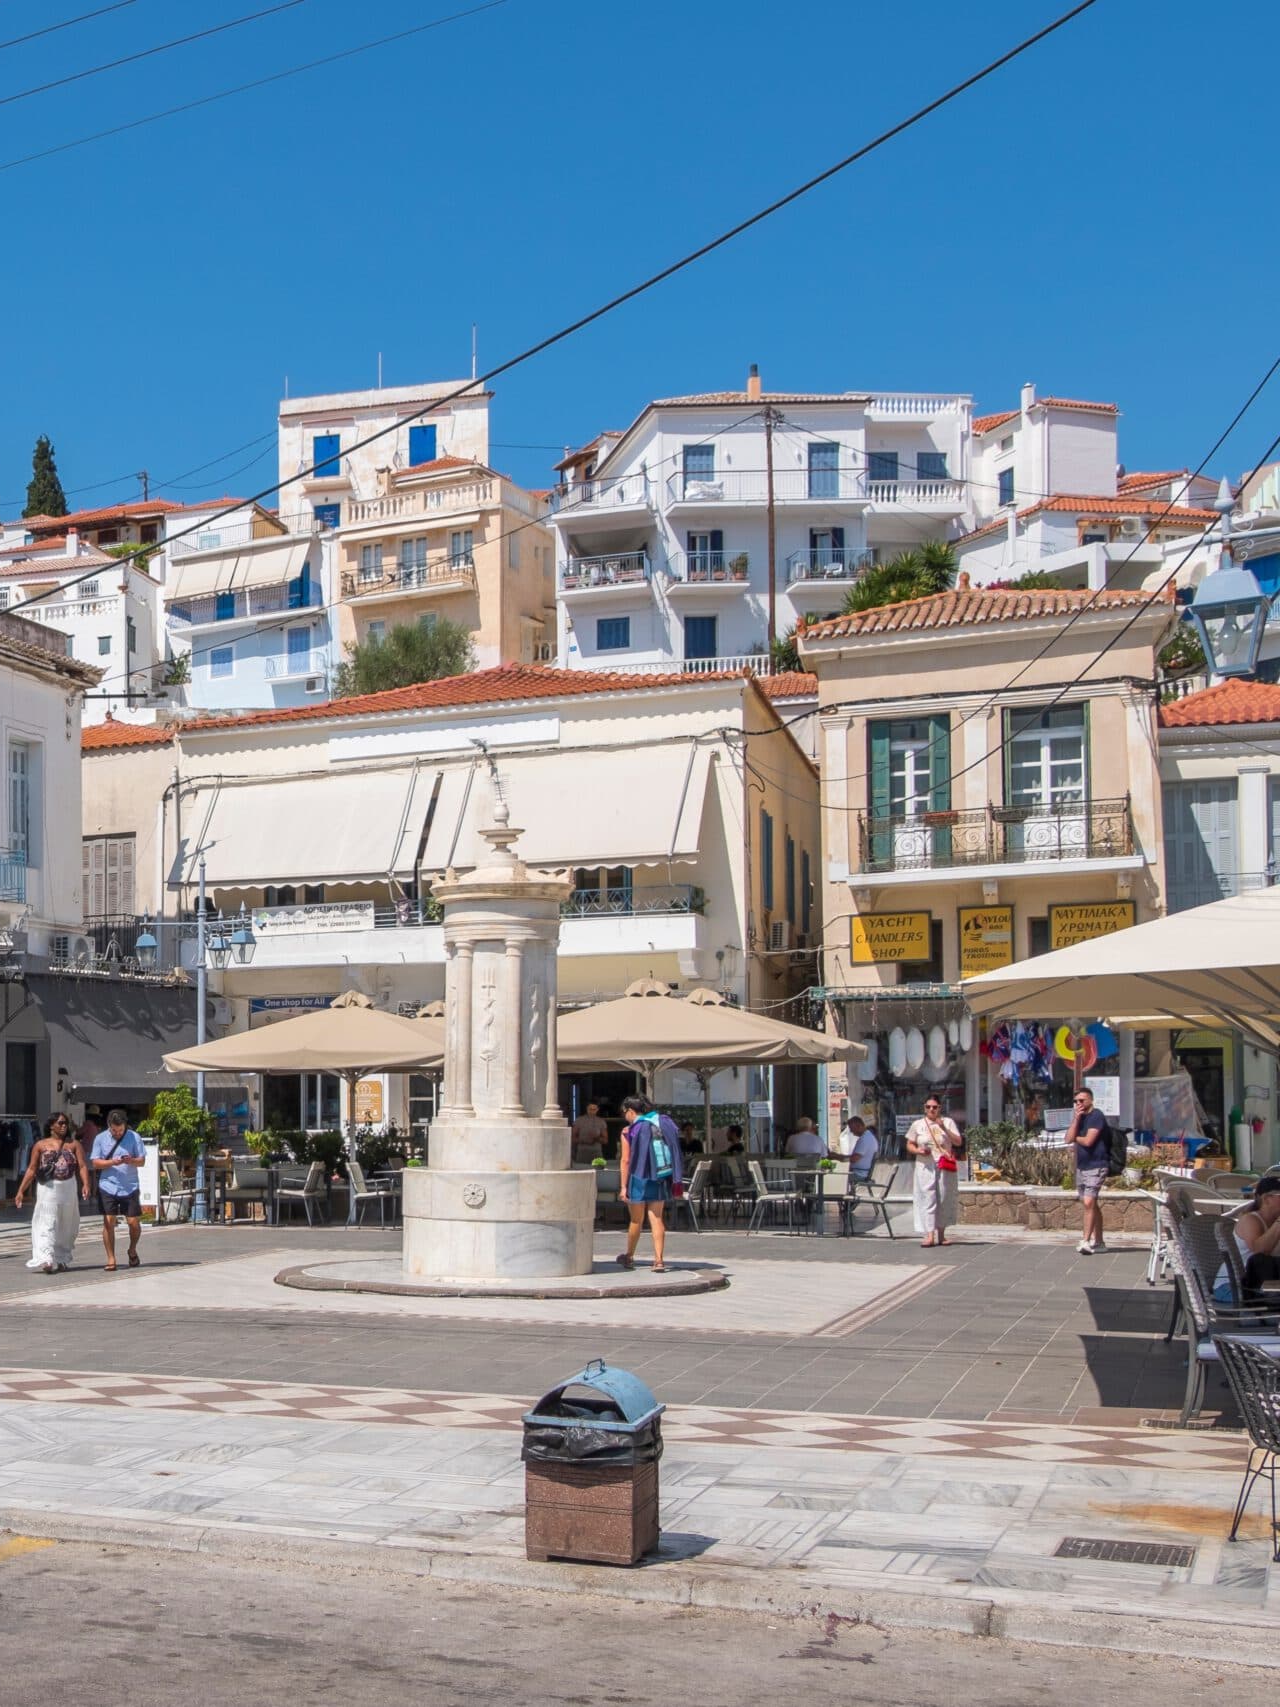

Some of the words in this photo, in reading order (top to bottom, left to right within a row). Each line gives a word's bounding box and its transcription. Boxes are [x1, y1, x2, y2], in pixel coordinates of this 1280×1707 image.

[1055, 906, 1127, 920] ΝΑΥΤΙΛΙΑΚΑ
[868, 916, 915, 928] YACHT
[1059, 921, 1118, 933] ΧΡΩΜΑΤΑ
[856, 931, 924, 944] CHANDLERS
[872, 948, 905, 958] SHOP
[264, 999, 281, 1007] One
[281, 998, 300, 1008] shop
[301, 998, 313, 1006] for
[314, 998, 325, 1006] All
